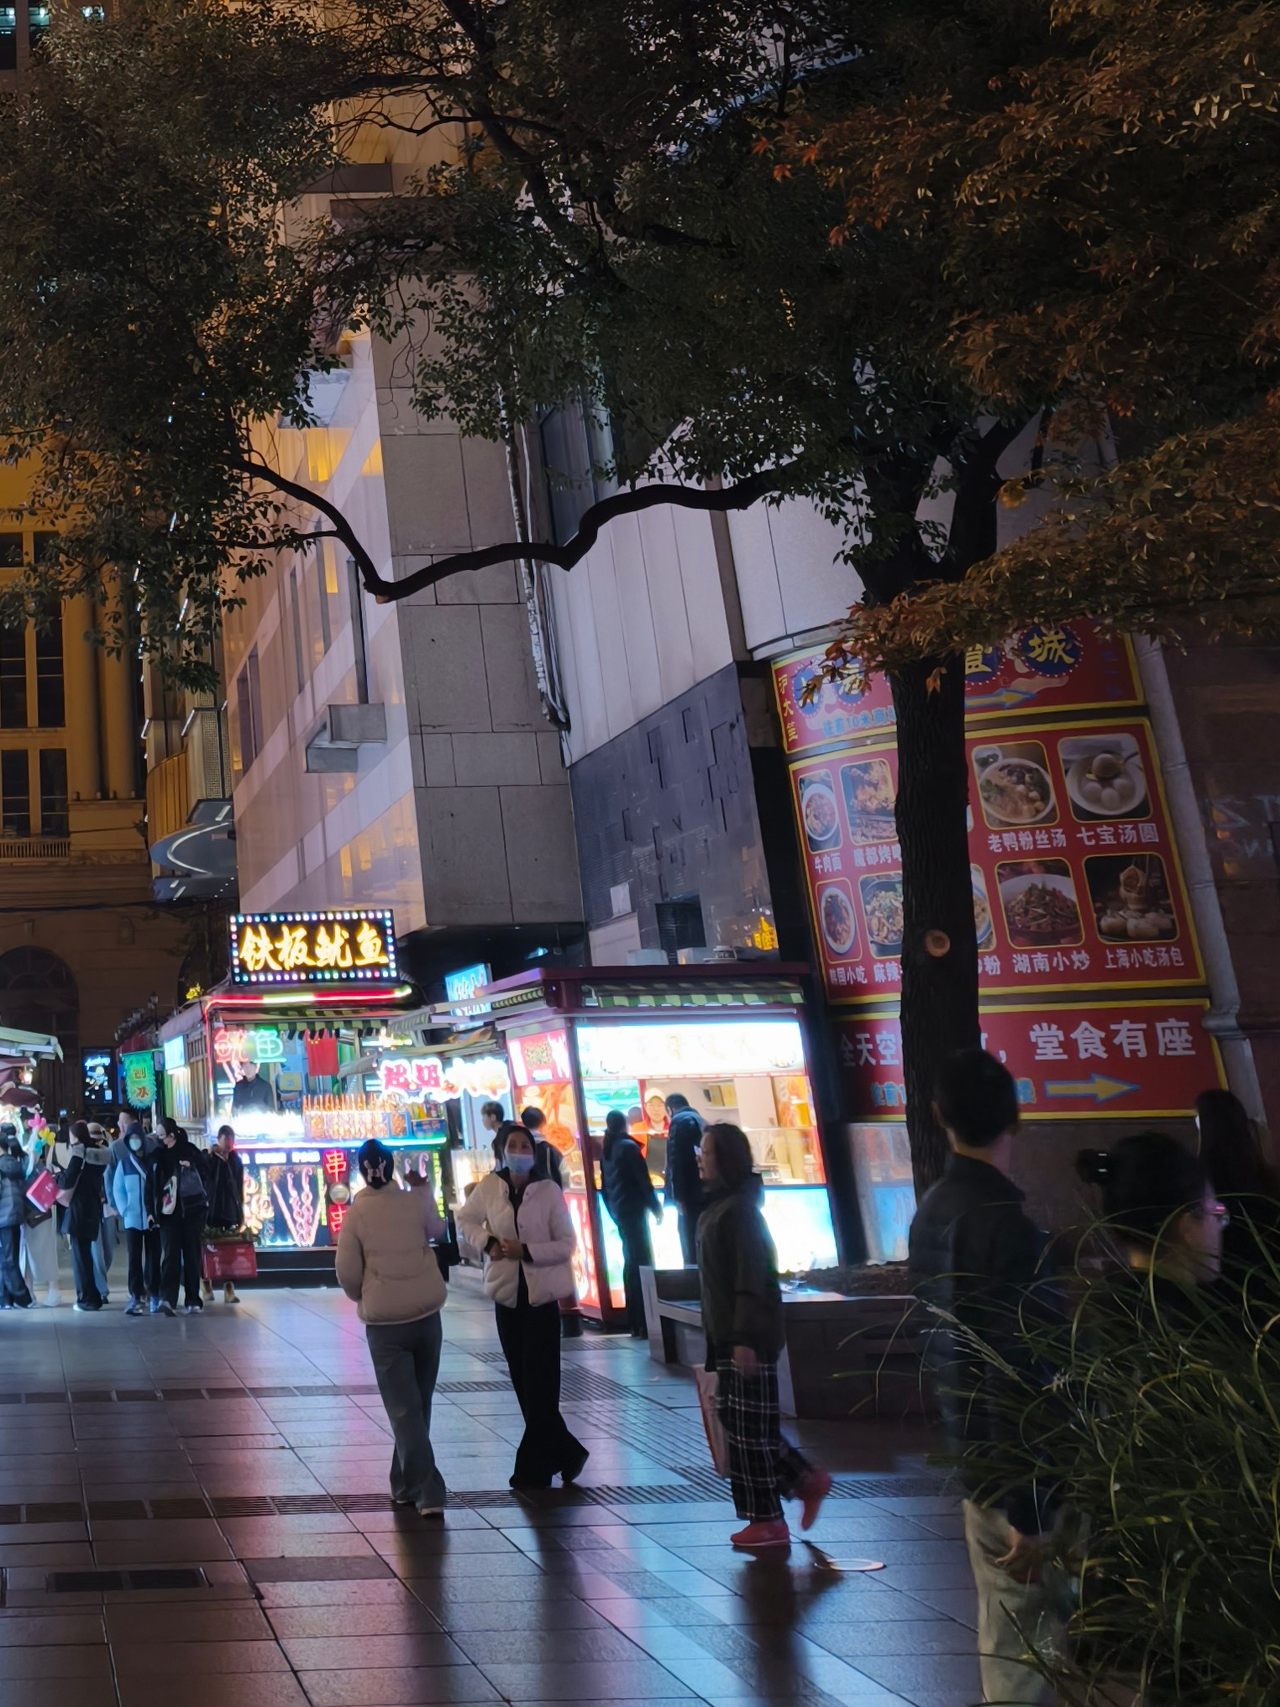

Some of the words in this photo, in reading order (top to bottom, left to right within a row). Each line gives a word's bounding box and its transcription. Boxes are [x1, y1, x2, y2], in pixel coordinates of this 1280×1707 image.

[987, 828, 1067, 853] 老鸭粉丝汤
[1076, 823, 1159, 846] 七宝汤圆
[239, 921, 389, 972] 铁板鱿鱼
[1013, 950, 1090, 974] 湖南小炒
[1105, 946, 1184, 970] 上海小吃汤包
[873, 961, 903, 983] 麻辣
[1030, 1017, 1196, 1061] 堂食有座
